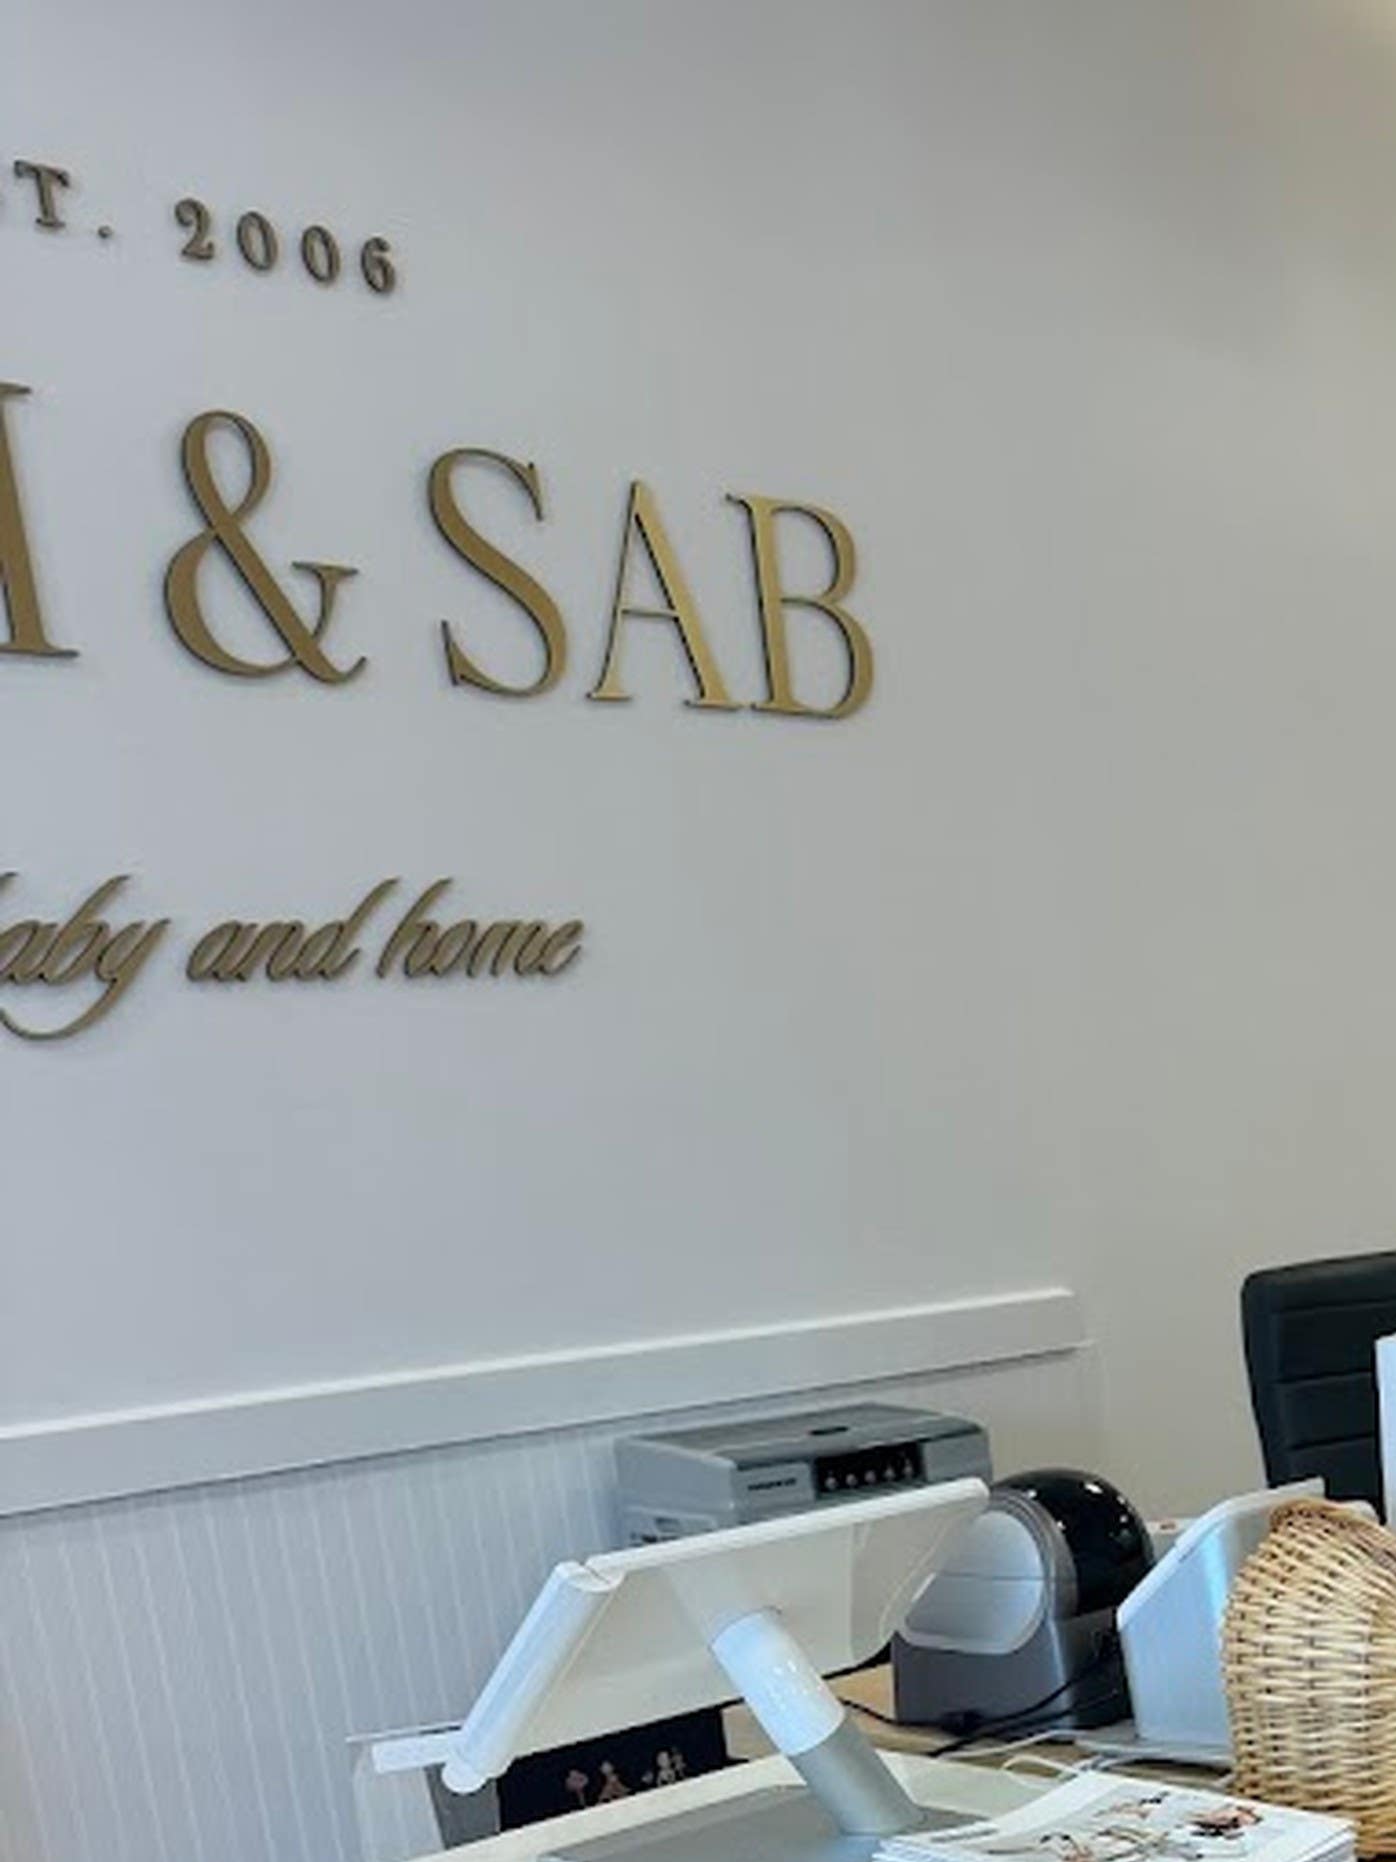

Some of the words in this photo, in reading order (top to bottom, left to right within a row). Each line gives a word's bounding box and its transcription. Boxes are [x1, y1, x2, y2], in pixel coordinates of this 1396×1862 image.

[174, 198, 395, 293] 2006
[163, 411, 367, 684] &
[427, 447, 873, 720] SAB
[186, 876, 402, 982] and
[376, 877, 584, 980] home
